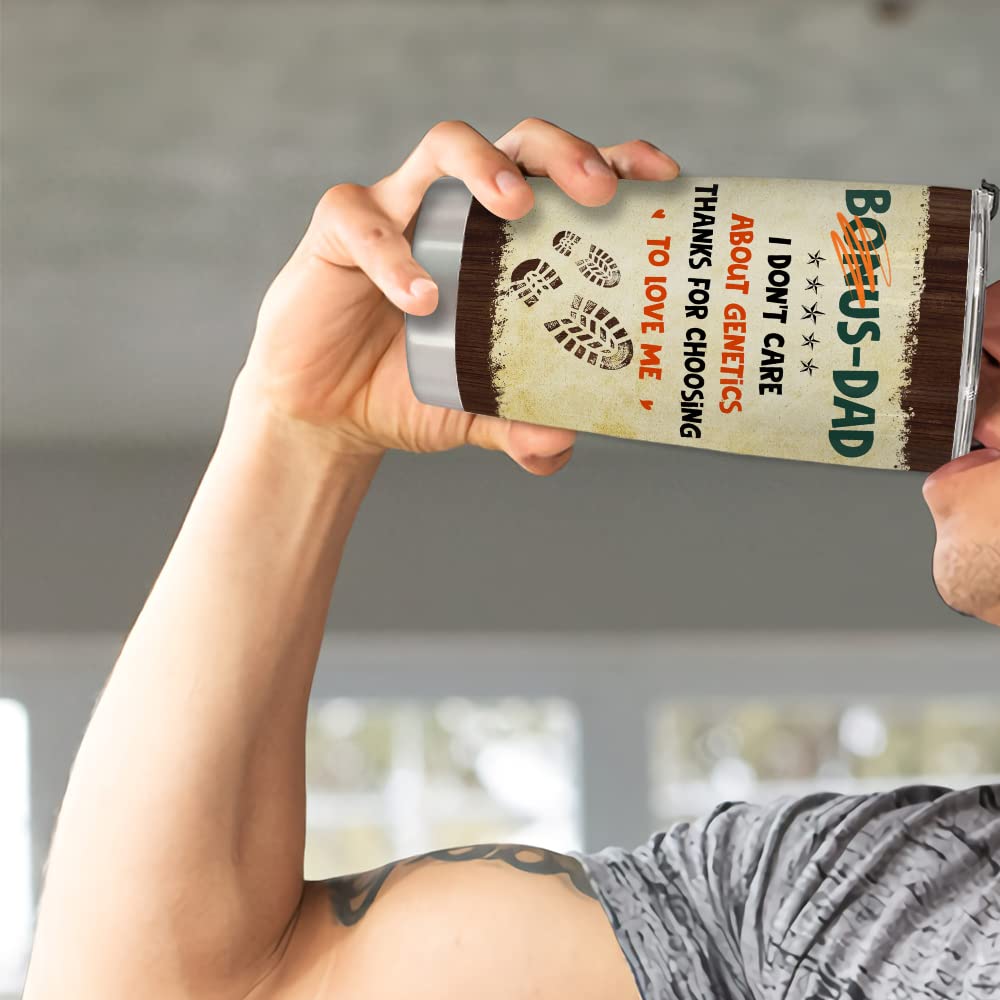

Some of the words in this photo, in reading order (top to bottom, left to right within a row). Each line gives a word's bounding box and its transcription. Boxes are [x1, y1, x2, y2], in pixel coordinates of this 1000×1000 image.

[646, 236, 671, 267] TO
[688, 184, 718, 269] THANKS
[725, 213, 754, 295] ABOUT
[768, 236, 792, 246] I
[641, 276, 667, 334] LOVE
[685, 278, 711, 319] FOR
[763, 254, 792, 324] DON'T
[828, 189, 891, 458] BONUS-DAD
[639, 344, 662, 380] ME
[759, 333, 785, 395] CARE
